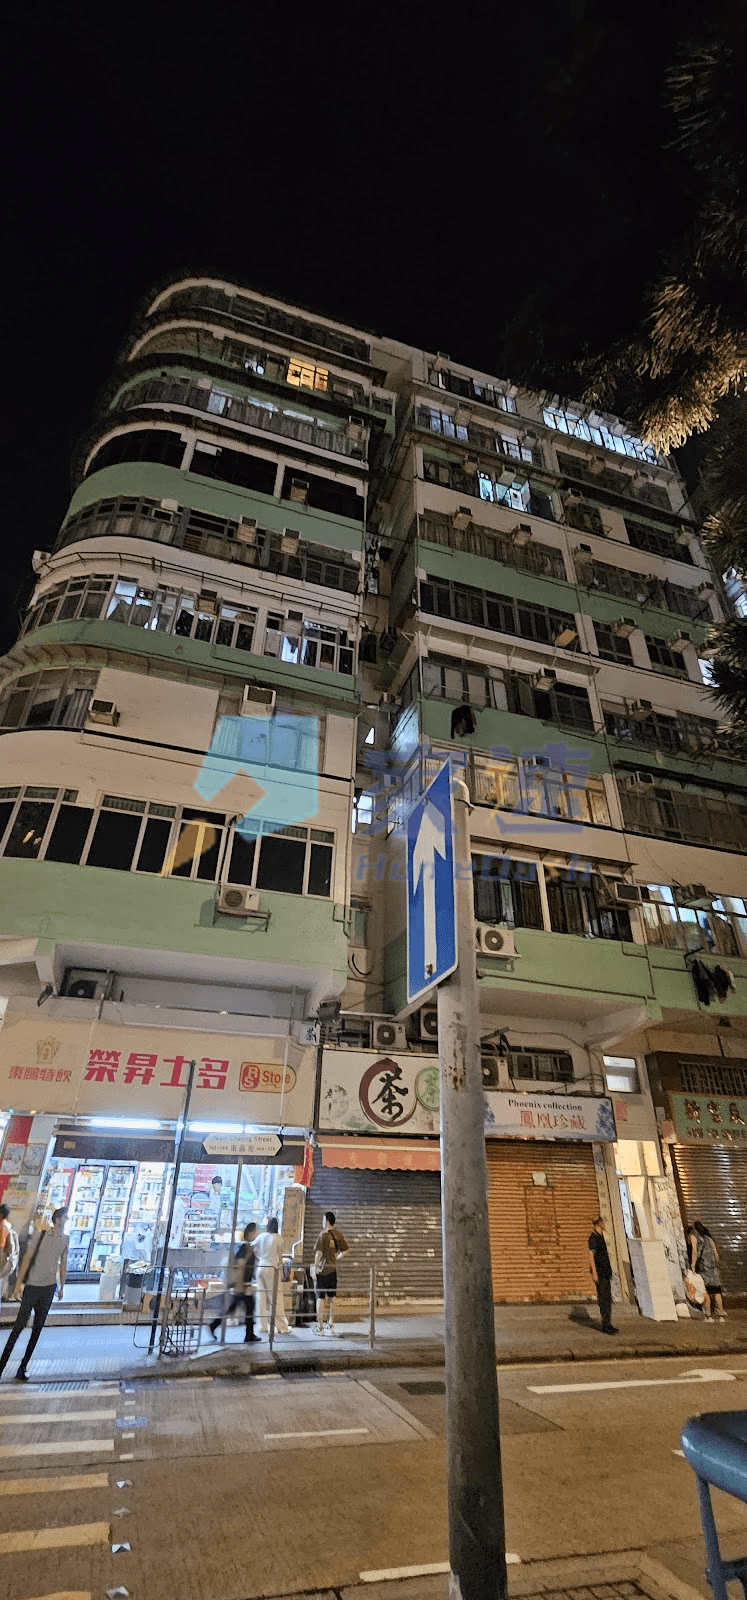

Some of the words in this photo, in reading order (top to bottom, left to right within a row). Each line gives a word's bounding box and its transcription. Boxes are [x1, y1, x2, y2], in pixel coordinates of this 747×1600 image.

[84, 1048, 230, 1090] 榮昇士多
[508, 1099, 541, 1108] Phoenix
[543, 1102, 583, 1111] collection
[520, 1110, 587, 1130] 鳳凰珍藏
